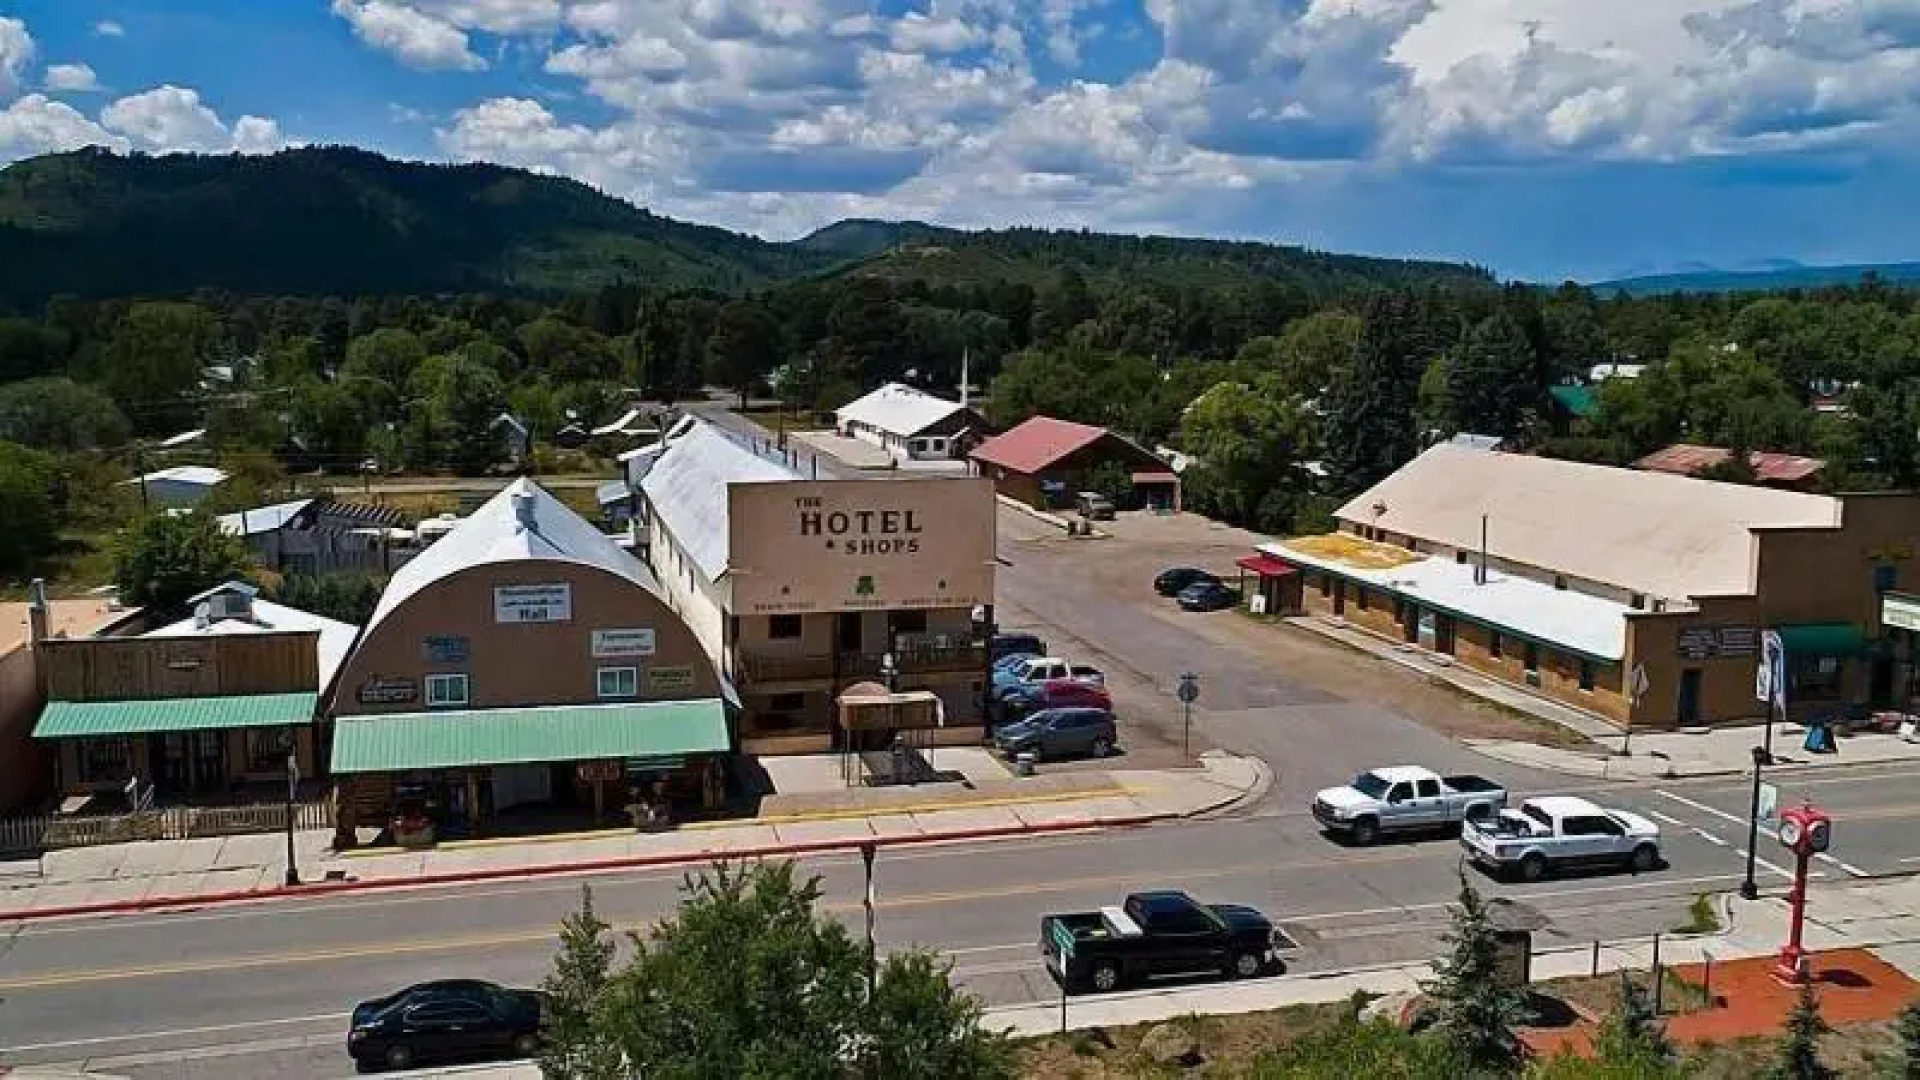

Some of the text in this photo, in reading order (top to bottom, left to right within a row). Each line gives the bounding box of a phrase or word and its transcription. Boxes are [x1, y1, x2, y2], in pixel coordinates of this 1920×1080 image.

[795, 497, 822, 508] THE
[801, 511, 922, 535] HOTEL
[845, 539, 919, 554] SHOPS
